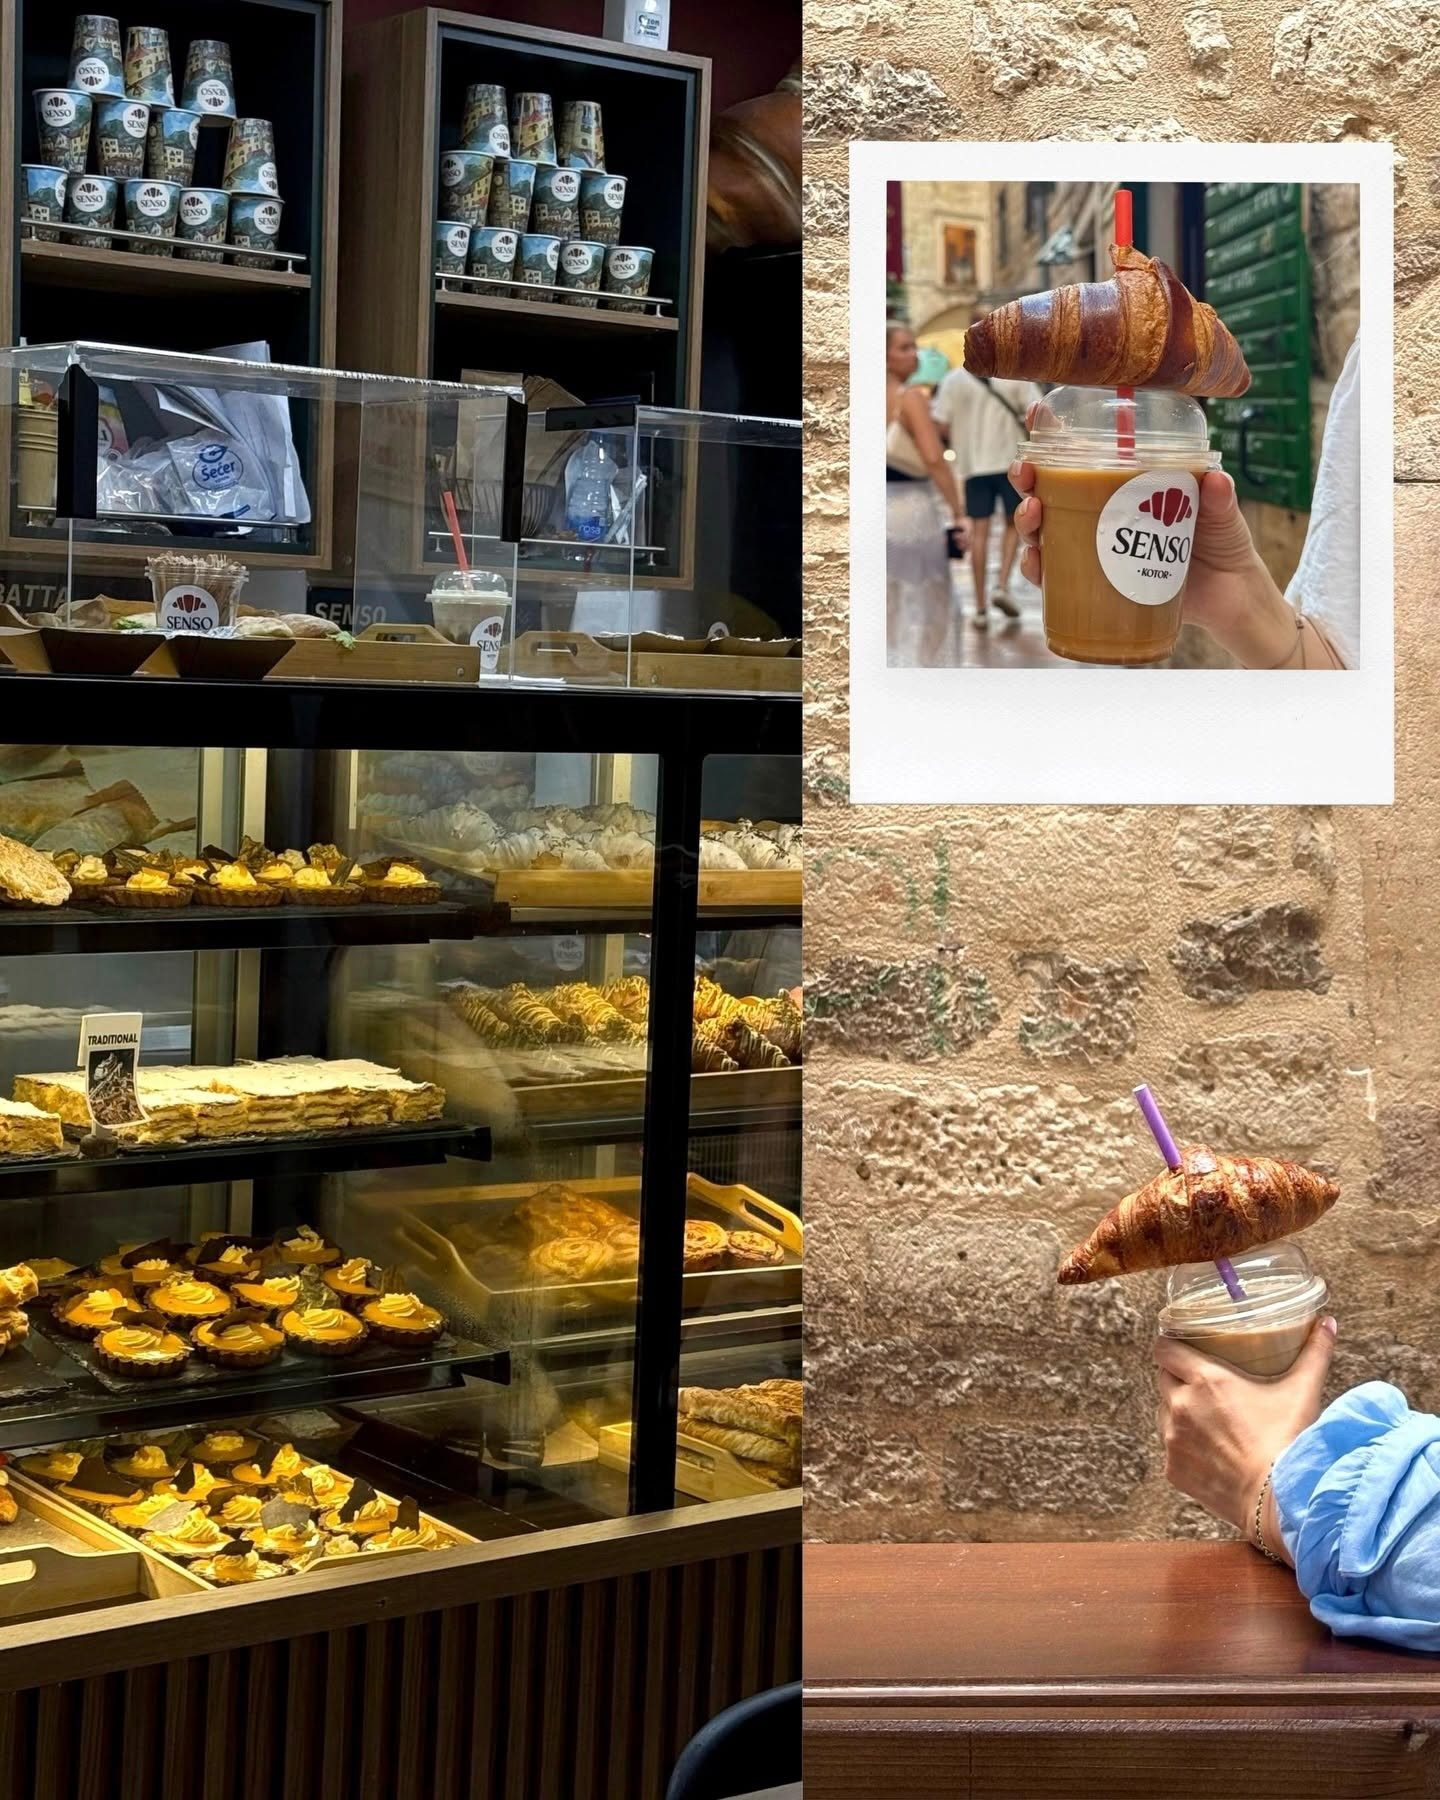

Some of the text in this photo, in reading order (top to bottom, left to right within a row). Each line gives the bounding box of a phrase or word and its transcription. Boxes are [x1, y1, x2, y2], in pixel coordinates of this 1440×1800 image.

[44, 109, 72, 119] SENSO
[76, 194, 103, 204] SENSO
[140, 199, 167, 208] SENSO
[182, 207, 208, 218] SENSO
[564, 259, 589, 267] SENSO
[612, 263, 636, 272] SENSO
[1111, 527, 1191, 564] SENSO
[315, 602, 387, 627] SENSO
[166, 616, 213, 631] SENSO
[88, 1033, 138, 1046] TRADITIONAL
